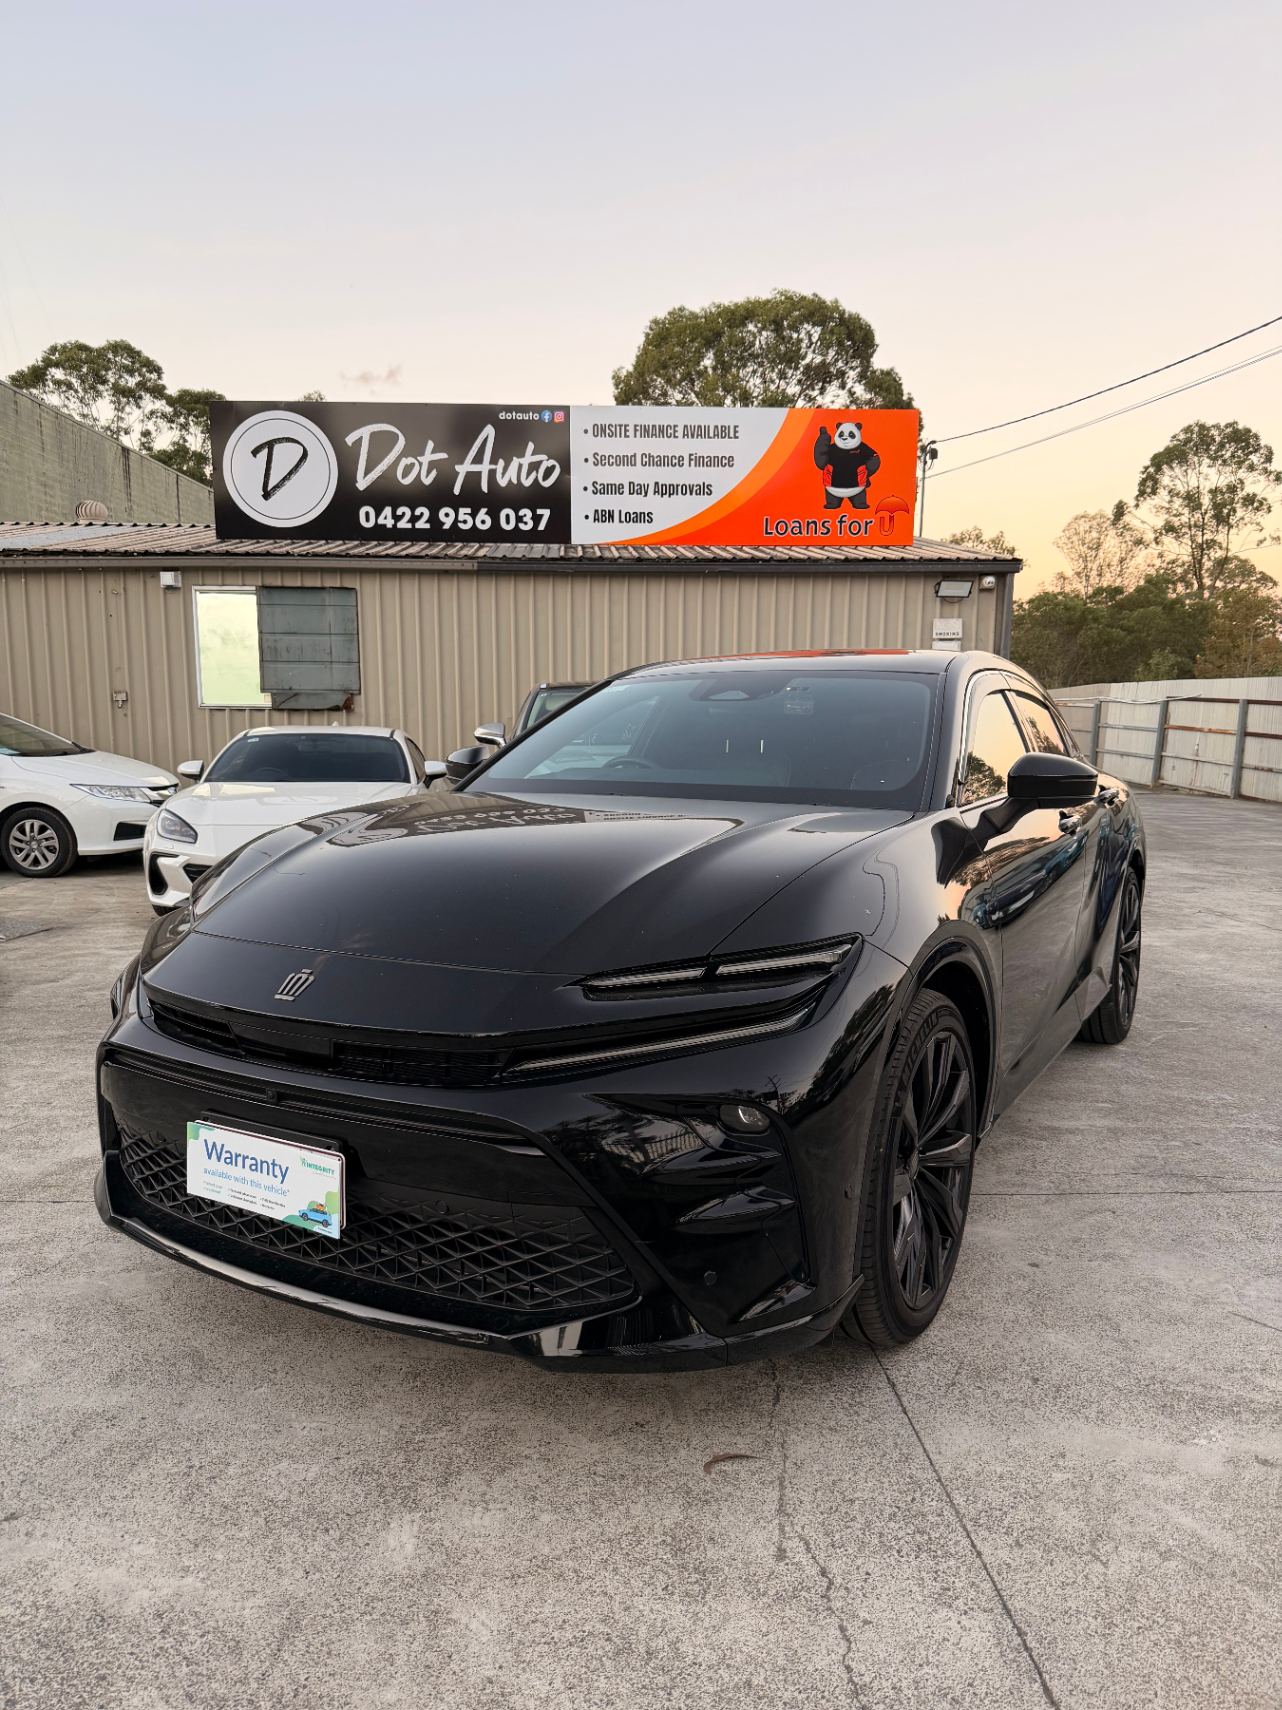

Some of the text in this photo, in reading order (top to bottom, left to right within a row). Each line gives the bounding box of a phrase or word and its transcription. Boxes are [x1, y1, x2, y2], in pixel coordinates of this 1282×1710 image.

[499, 411, 540, 420] dotauto
[592, 424, 739, 440] ONSITE FINANCE AVAILABLE
[251, 437, 308, 501] D
[345, 423, 561, 496] Dot Auto
[592, 452, 735, 468] Second Chance Finance
[592, 481, 713, 498] Same Day Approvals
[359, 505, 551, 531] 0422 956 037
[593, 509, 654, 524] ABN Loans
[763, 516, 832, 537] Loans
[837, 514, 874, 537] for
[203, 1138, 289, 1185] Warranty
[203, 1167, 233, 1181] available
[234, 1175, 249, 1185] with
[250, 1178, 262, 1190] this
